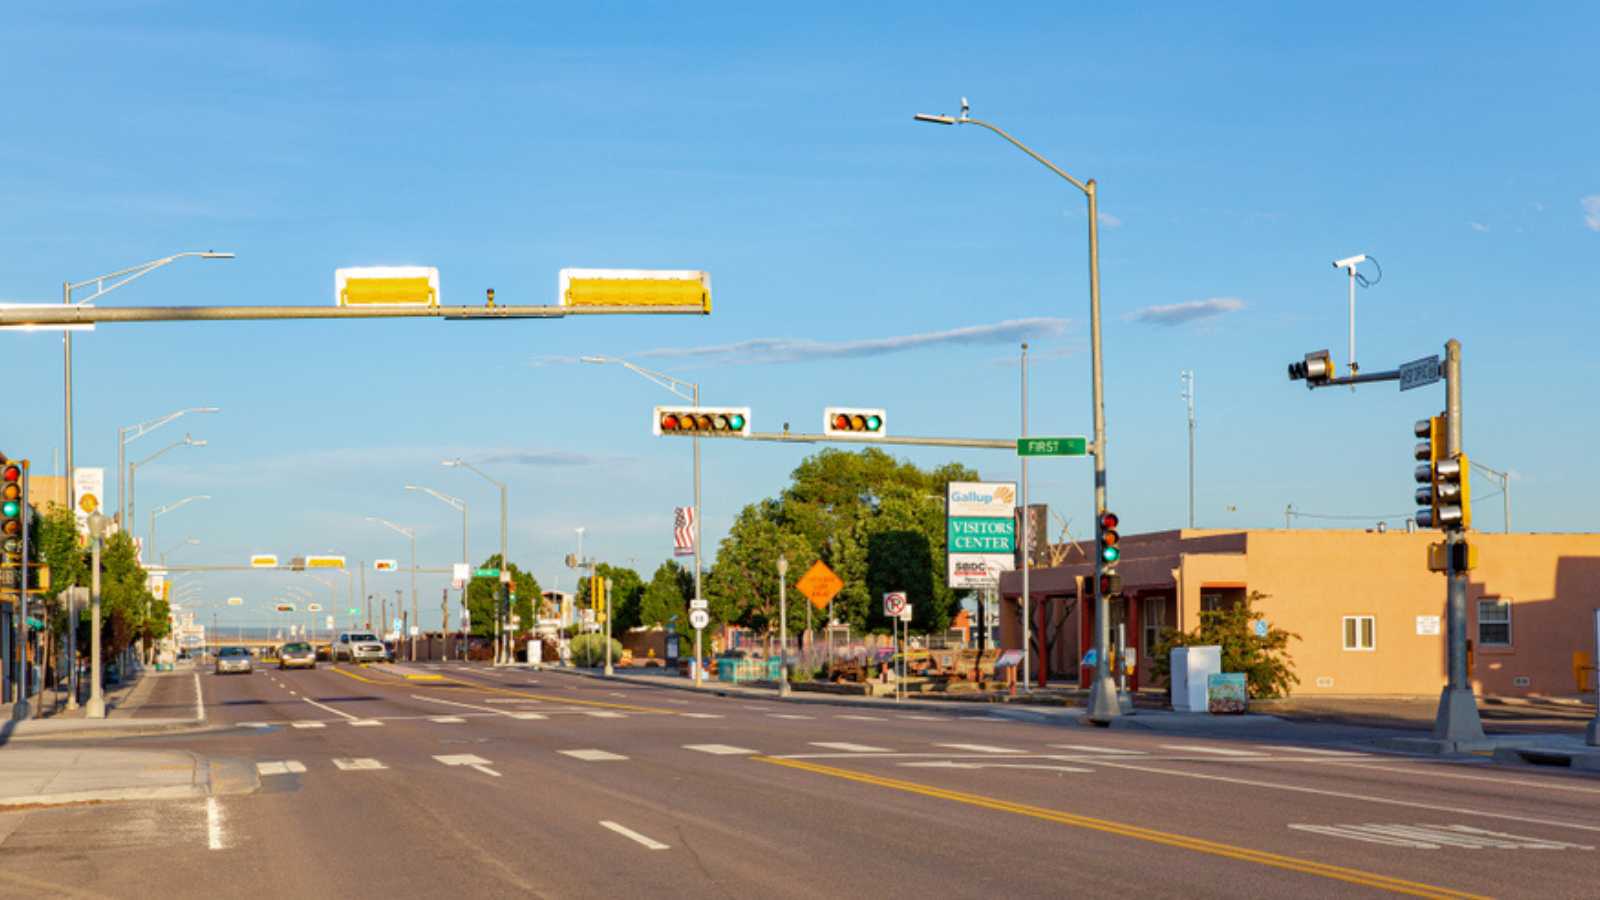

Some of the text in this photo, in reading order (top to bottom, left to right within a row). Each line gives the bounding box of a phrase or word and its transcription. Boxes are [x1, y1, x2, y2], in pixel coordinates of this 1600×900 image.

[1028, 440, 1059, 453] FIRST
[951, 488, 992, 504] Gallup
[952, 520, 1012, 534] VISITORS
[955, 537, 1009, 549] CENTER
[955, 562, 985, 571] SBDC
